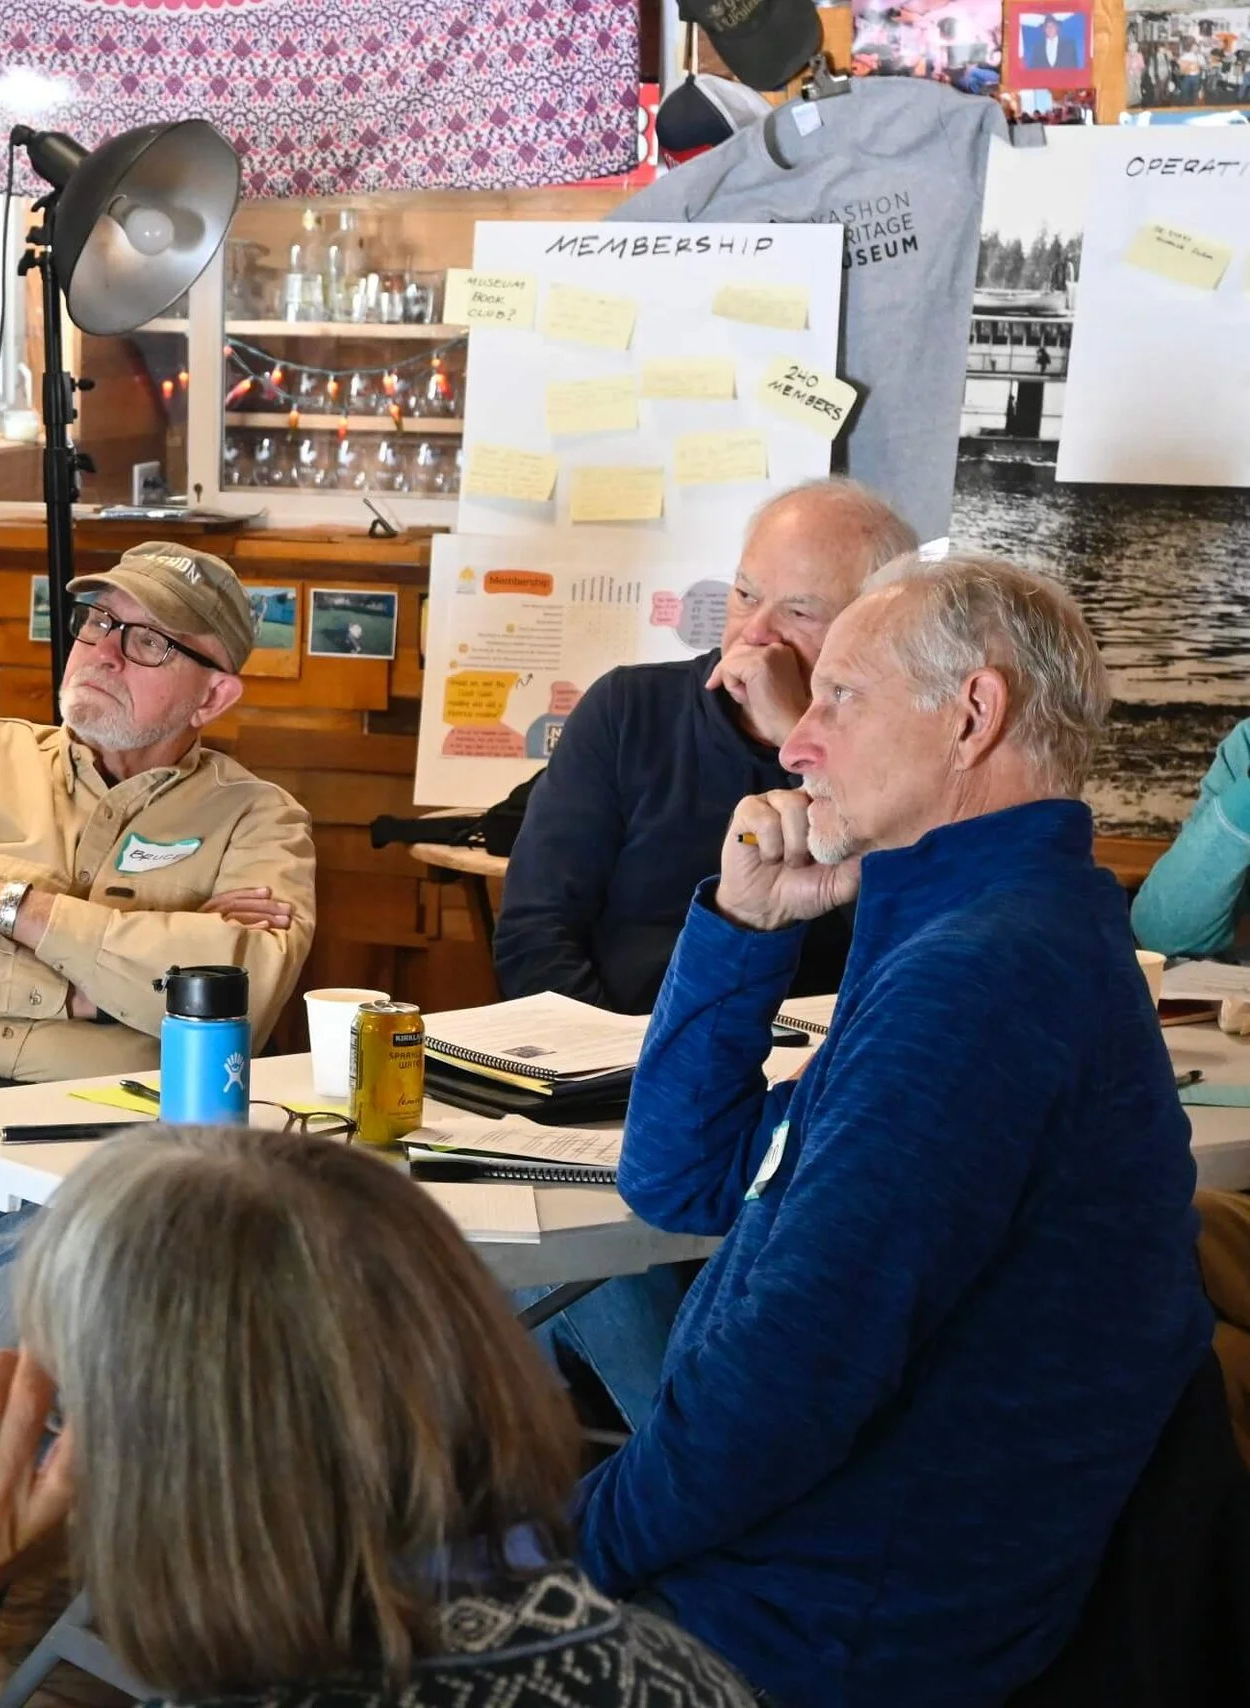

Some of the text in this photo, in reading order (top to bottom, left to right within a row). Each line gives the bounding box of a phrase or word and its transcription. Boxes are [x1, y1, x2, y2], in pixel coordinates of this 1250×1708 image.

[547, 236, 773, 258] MEMBERSHIP
[465, 277, 525, 290] MUSEUM
[472, 291, 505, 305] BOOK
[467, 308, 517, 321] CLUB?
[784, 365, 818, 387] 240
[768, 381, 842, 420] MEMBERS
[489, 576, 550, 589] Membership
